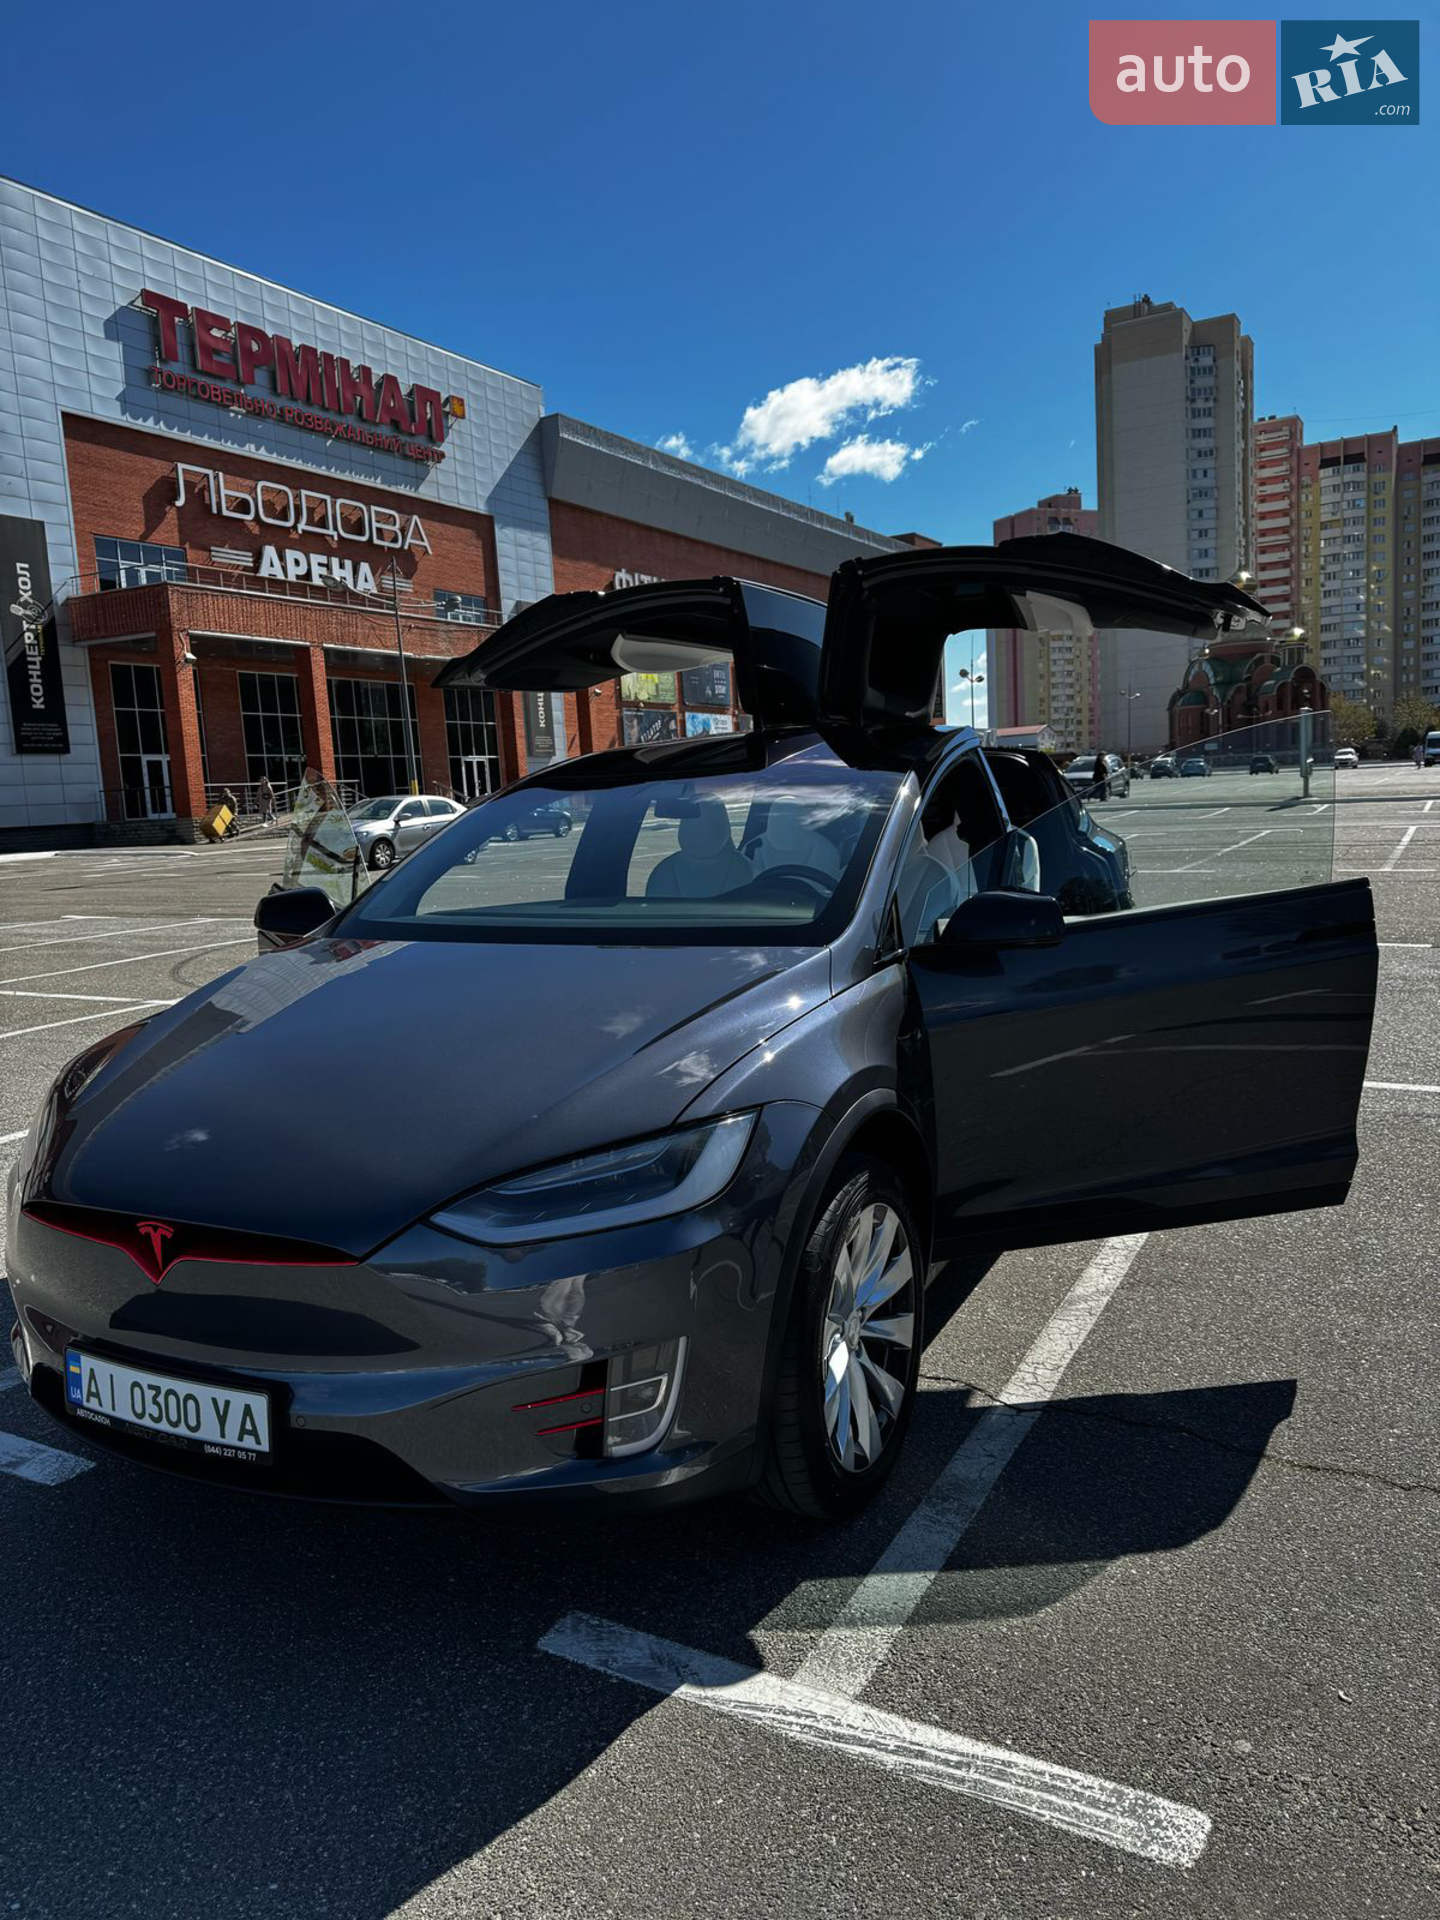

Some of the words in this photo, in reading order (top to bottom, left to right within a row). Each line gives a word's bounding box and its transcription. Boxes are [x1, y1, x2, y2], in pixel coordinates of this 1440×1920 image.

[142, 288, 444, 442] ТЕРМІНАЛ
[404, 441, 446, 464] ЦЕНТР
[174, 462, 432, 555] ЛЬОДОВА
[16, 562, 33, 603] ХОЛ
[258, 545, 378, 594] АРЕНА
[22, 620, 45, 709] КОНЦЕРТ
[70, 1385, 81, 1400] UA
[86, 1367, 116, 1412] AI
[130, 1381, 201, 1433] 0300
[211, 1397, 262, 1446] YA
[203, 1444, 222, 1456] (044)
[223, 1446, 236, 1458] 227
